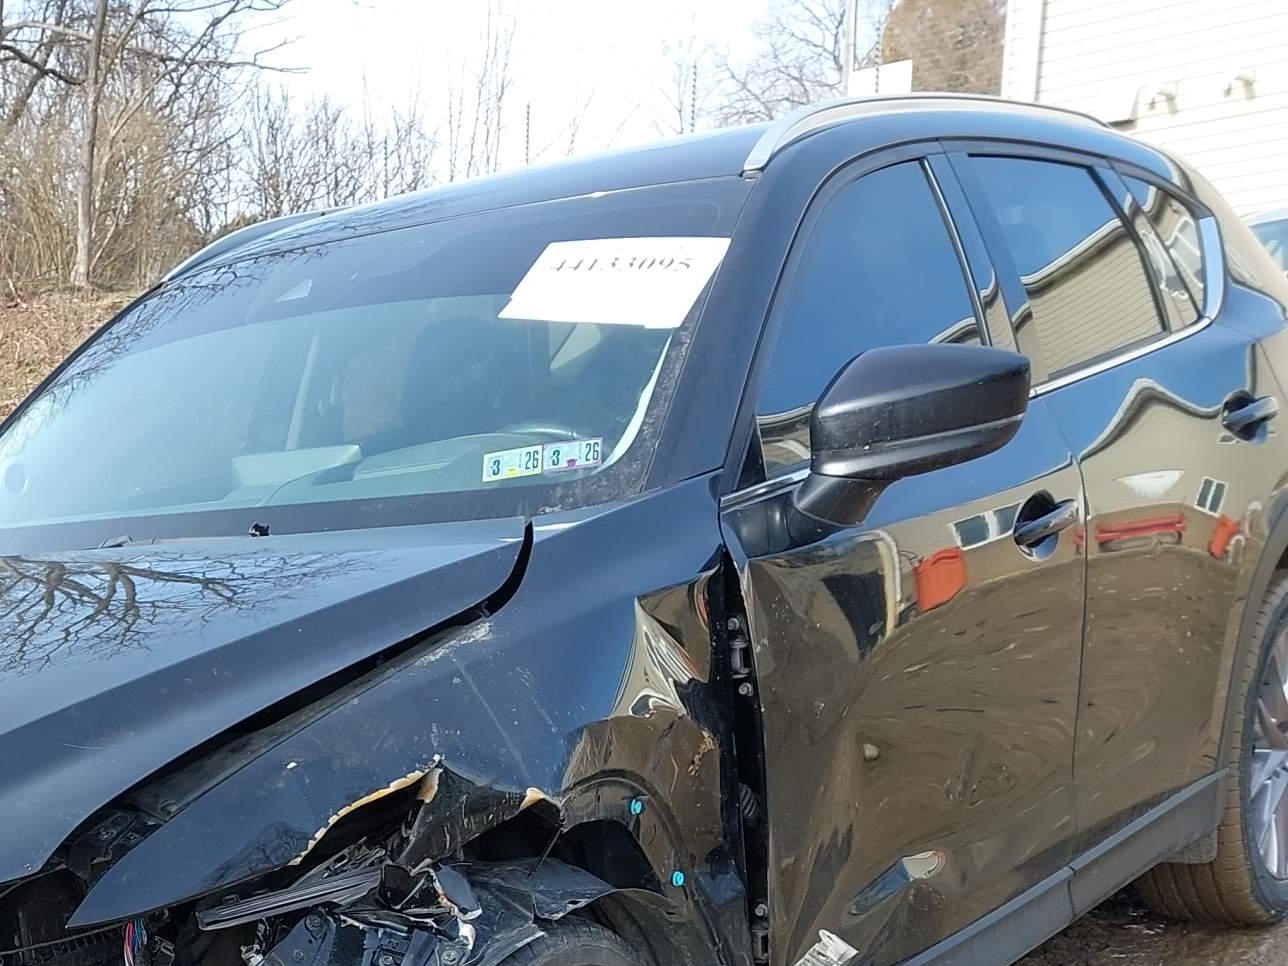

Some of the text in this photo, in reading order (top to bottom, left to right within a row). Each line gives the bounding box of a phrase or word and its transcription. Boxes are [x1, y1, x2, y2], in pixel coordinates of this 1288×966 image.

[492, 450, 539, 476] 3 26
[552, 442, 600, 466] 3 26
